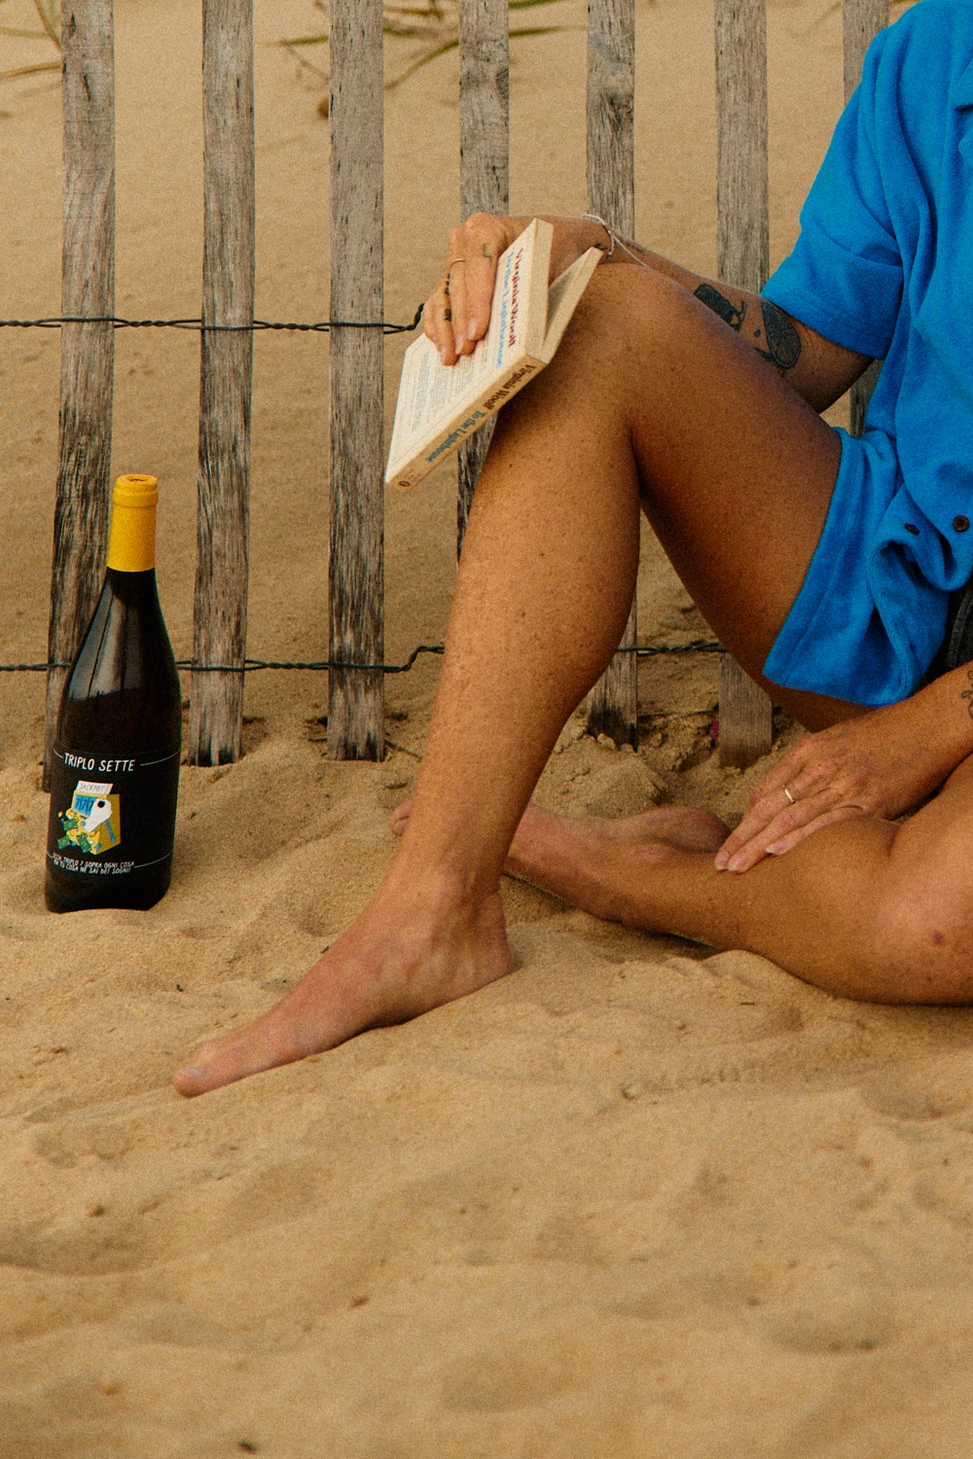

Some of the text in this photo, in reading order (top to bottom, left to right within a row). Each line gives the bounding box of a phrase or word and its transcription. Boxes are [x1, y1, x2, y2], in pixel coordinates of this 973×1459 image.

[511, 247, 524, 306] Virginia
[426, 363, 537, 463] Virginia Woolf To the Lighthouse
[64, 752, 136, 772] TRIPLO SETTE
